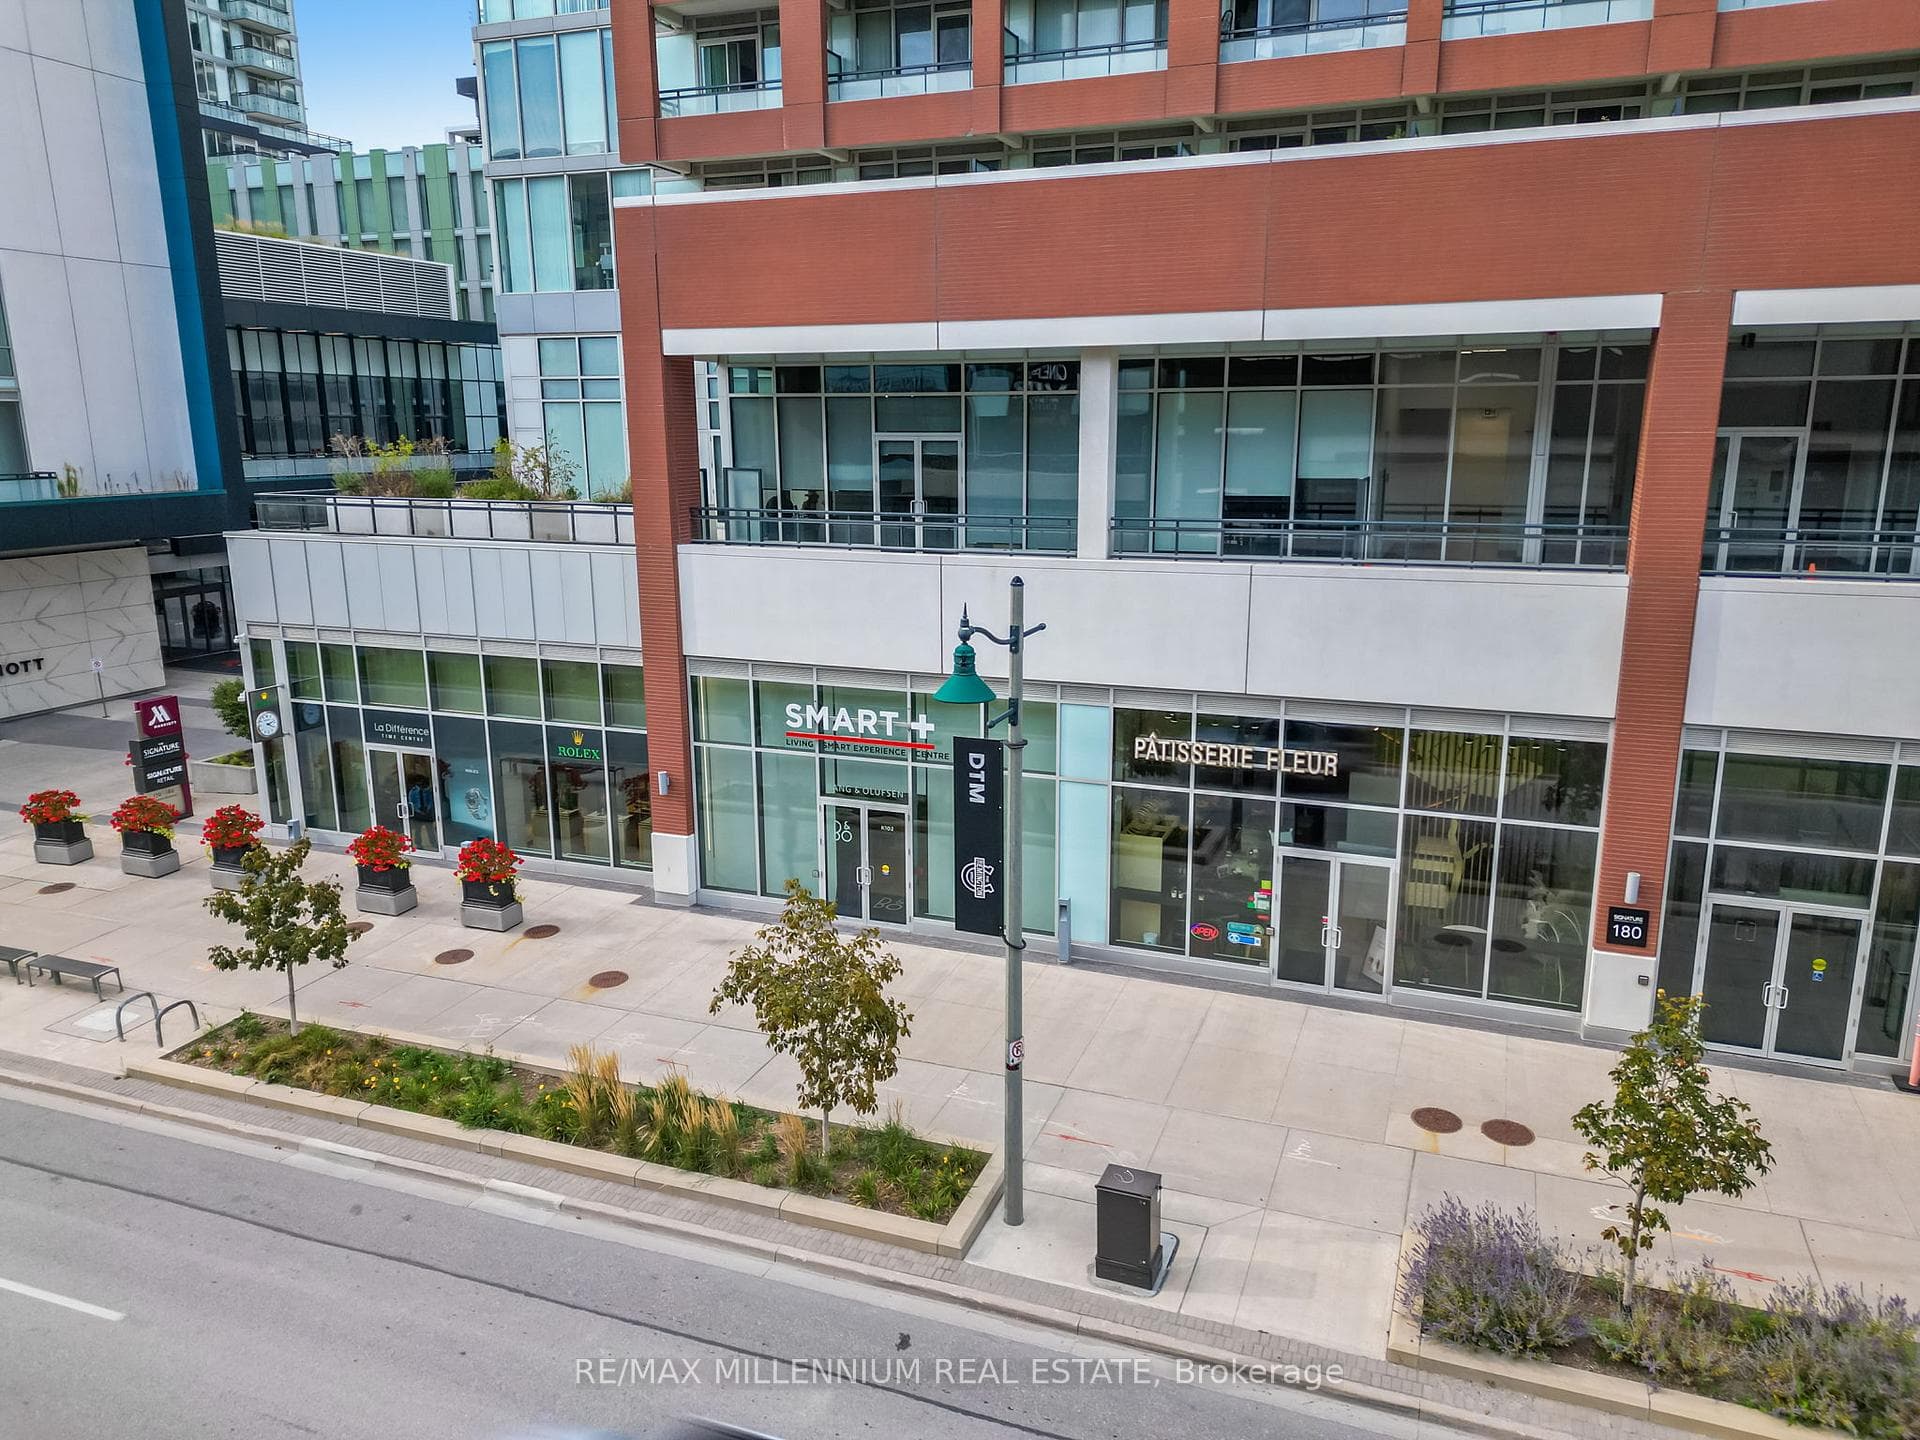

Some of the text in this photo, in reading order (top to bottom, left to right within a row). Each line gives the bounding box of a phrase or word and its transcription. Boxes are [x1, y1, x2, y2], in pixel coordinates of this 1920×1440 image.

[785, 703, 899, 736] SMART
[558, 746, 600, 760] ROLEX
[785, 739, 950, 761] LIVING SMART EXPERIENCE CENTRE
[1134, 732, 1338, 777] PÂTISSERIE FLEUR
[968, 752, 985, 804] DTM
[862, 786, 904, 798] OLUFSEN
[1612, 924, 1642, 940] 180
